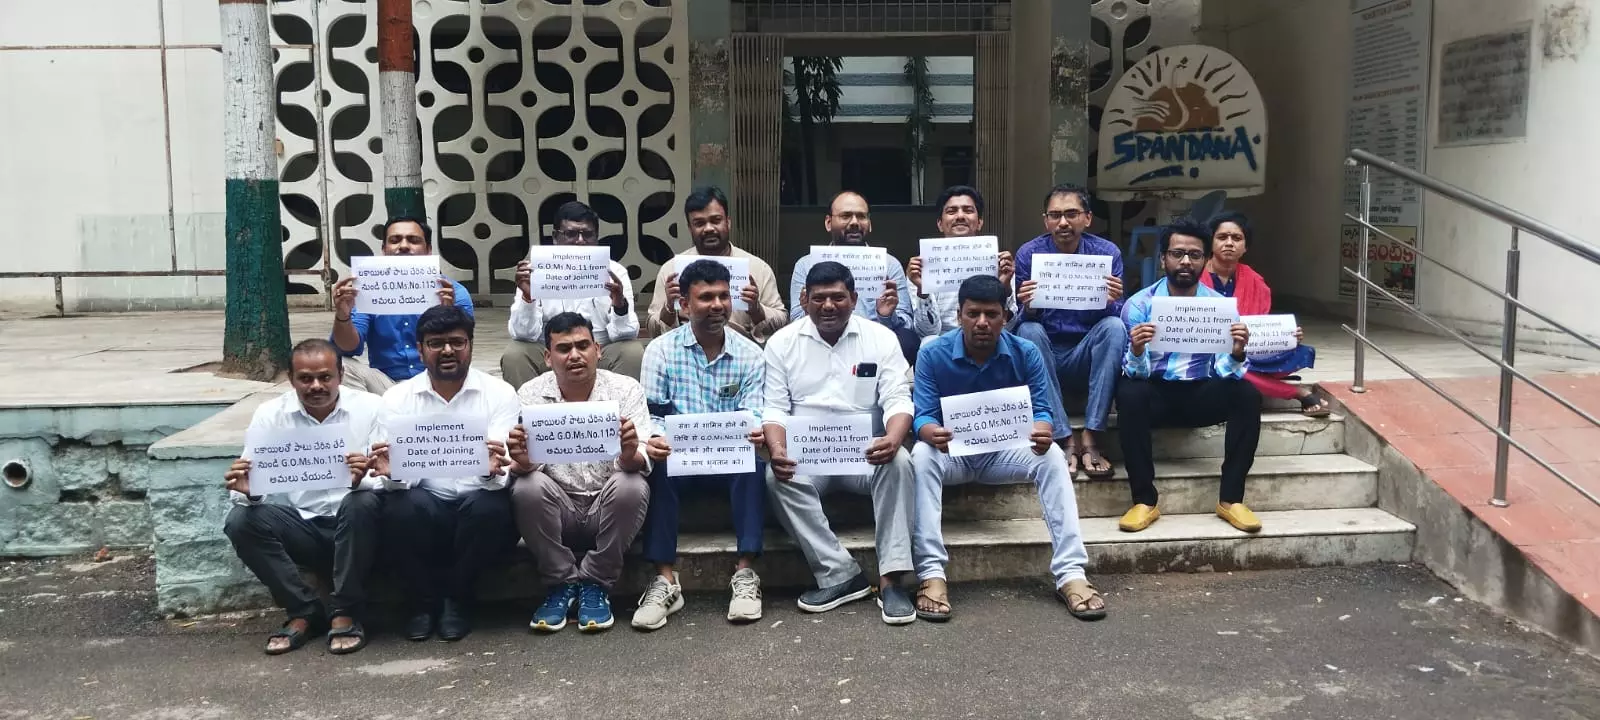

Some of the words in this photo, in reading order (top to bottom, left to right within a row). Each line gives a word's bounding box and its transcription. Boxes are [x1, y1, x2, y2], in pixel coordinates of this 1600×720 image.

[416, 424, 464, 432] Implement
[397, 435, 459, 444] G.O.Ms.No.11
[443, 446, 474, 455] Joining
